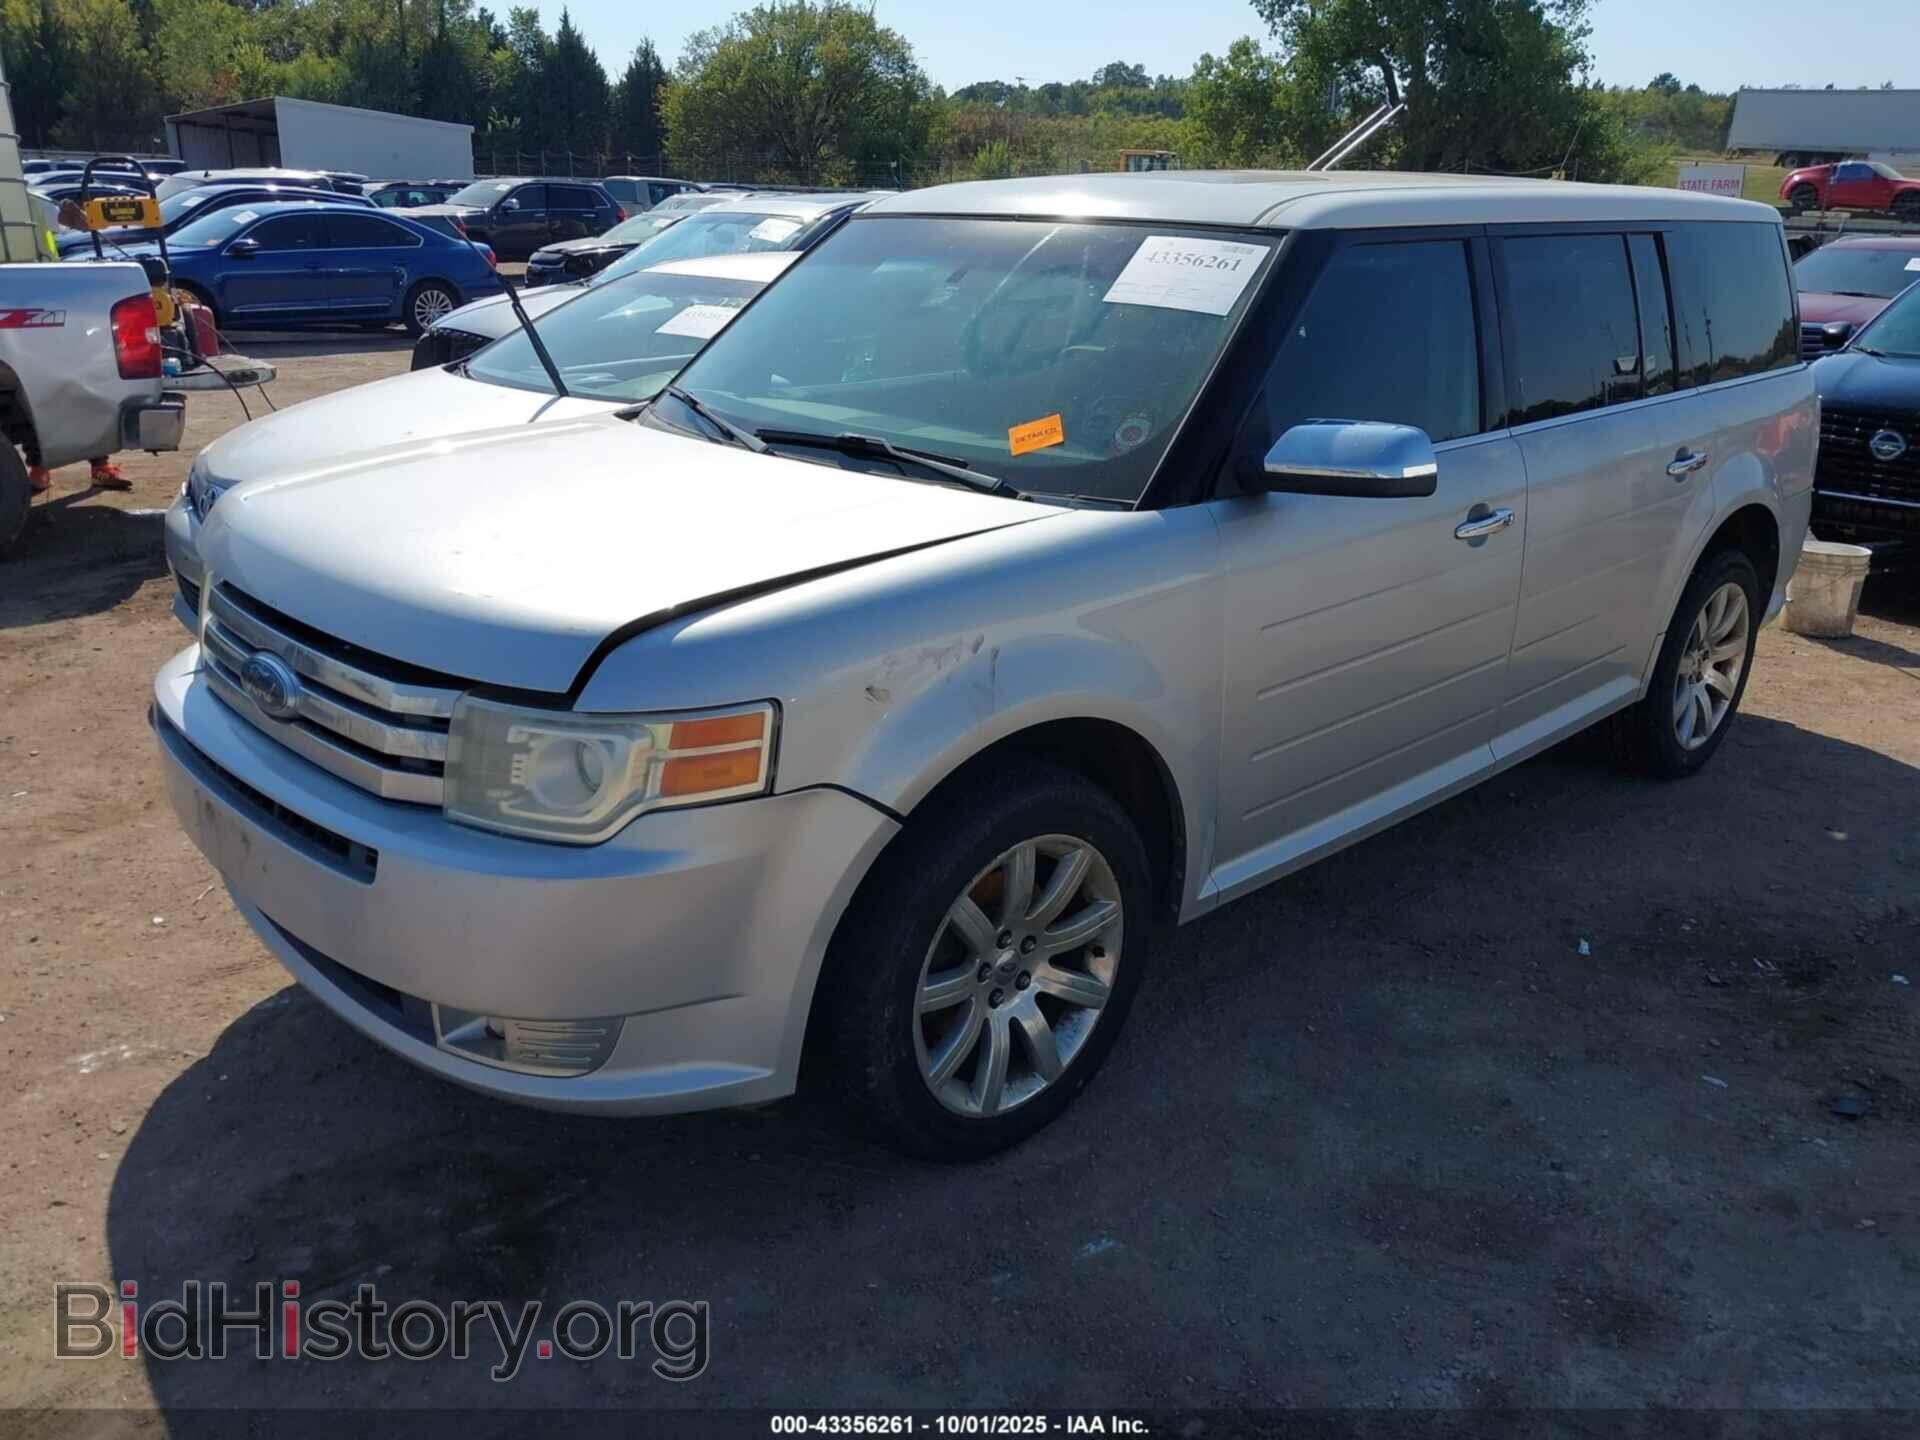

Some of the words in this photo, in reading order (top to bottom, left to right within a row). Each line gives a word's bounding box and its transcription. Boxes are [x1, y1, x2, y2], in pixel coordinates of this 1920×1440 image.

[1680, 178, 1710, 191] STATE
[1712, 179, 1740, 191] FARM
[1144, 251, 1242, 271] 43356261
